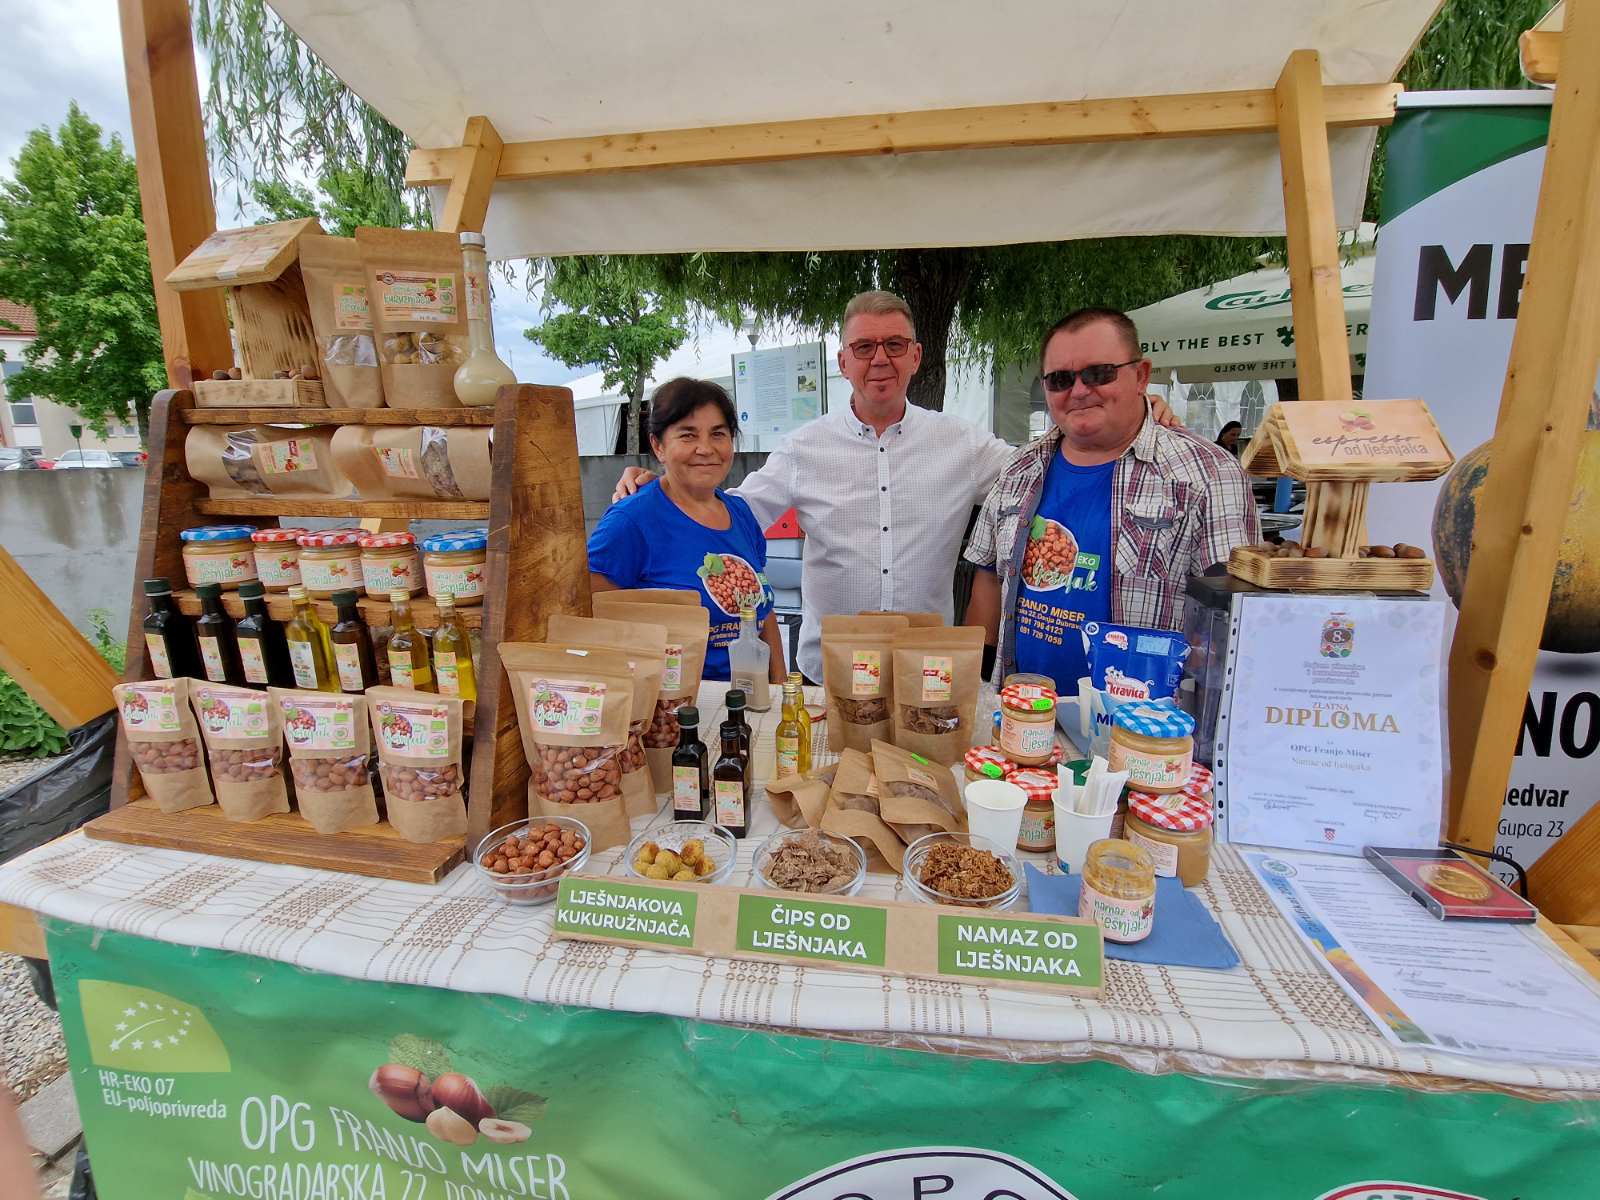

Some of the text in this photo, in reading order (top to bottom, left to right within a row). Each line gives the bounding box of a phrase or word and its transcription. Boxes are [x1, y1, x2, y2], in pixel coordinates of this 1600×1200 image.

[1177, 338, 1209, 350] THE
[1218, 332, 1265, 348] BEST
[1344, 444, 1361, 456] od
[1077, 555, 1096, 566] EKO
[1051, 606, 1086, 622] MISER
[1264, 706, 1401, 733] DIPLOMA
[1313, 702, 1350, 711] ZLATNA
[1290, 744, 1311, 753] OPG
[1346, 748, 1371, 758] Miser
[1503, 784, 1569, 808] edvar
[1497, 819, 1563, 838] Gupca 23
[570, 890, 683, 916] LJEŠNJAKOVA
[557, 909, 691, 938] KUKURUŽNJAČA
[771, 904, 851, 931] ČIPS OD
[752, 930, 867, 959] LJEŠNJAKA
[957, 925, 1078, 950] NAMAZ OD
[956, 949, 1081, 977] LJEŠNJAKA
[99, 1070, 175, 1096] HR-EKO 07
[103, 1088, 227, 1119] EU-poljoprivreda
[240, 1094, 571, 1200] OPG FRANJO MISER
[187, 1156, 386, 1200] VINOGRADARSKA
